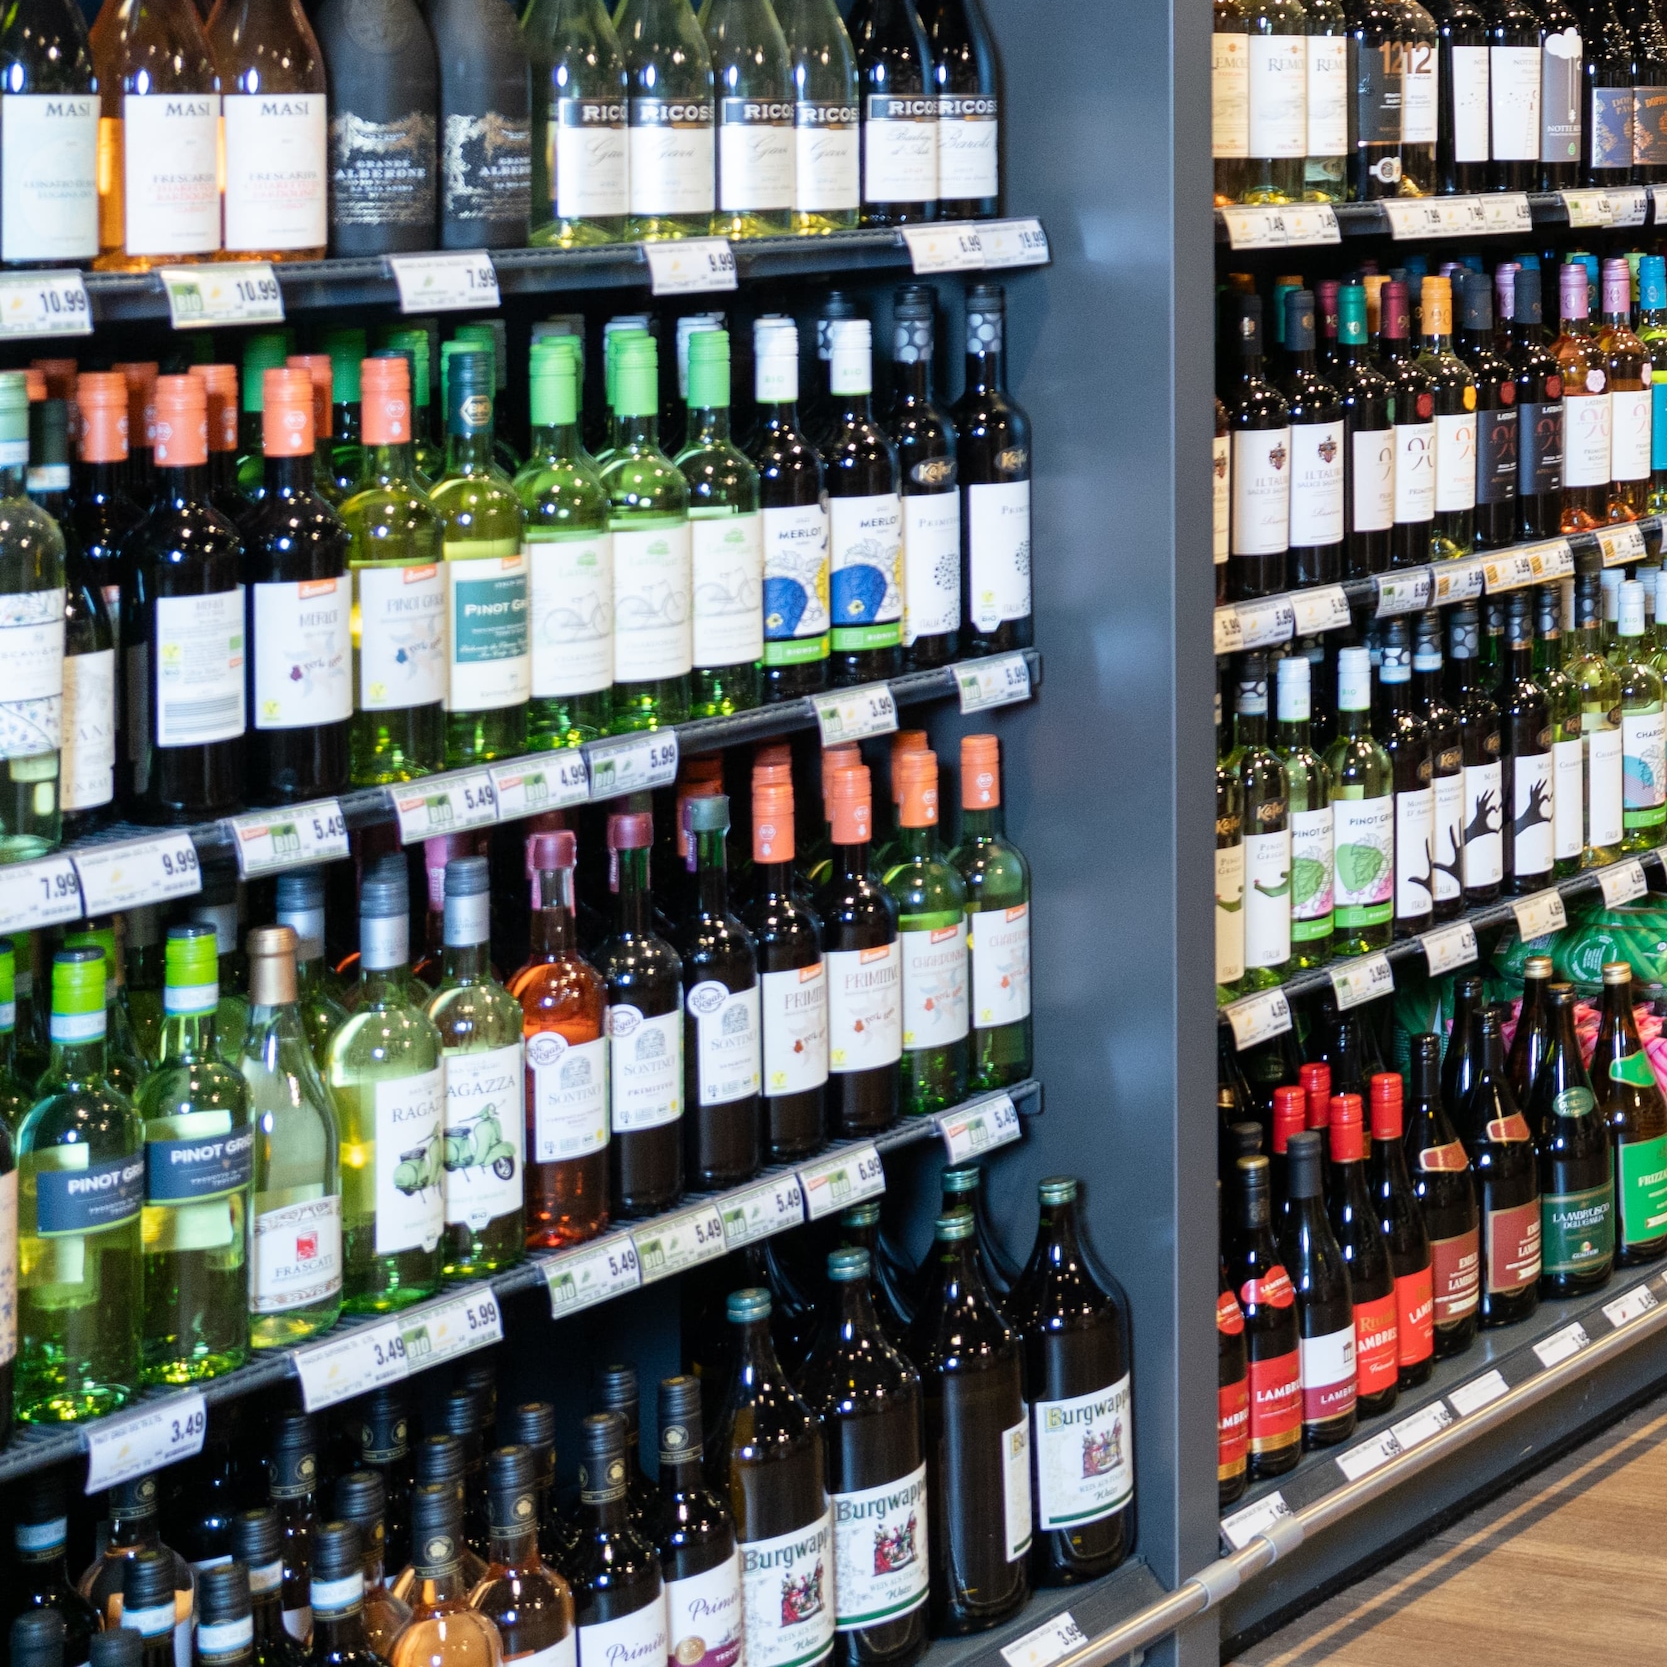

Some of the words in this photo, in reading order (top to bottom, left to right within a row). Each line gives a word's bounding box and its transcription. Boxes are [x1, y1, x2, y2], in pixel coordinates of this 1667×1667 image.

[45, 101, 90, 117] MASI
[166, 101, 211, 117] MASI
[260, 101, 310, 117] MASI
[709, 252, 734, 273] 9.99
[466, 269, 497, 289] 7.99
[39, 290, 86, 314] 10.99
[236, 280, 279, 302] 10.99
[860, 515, 899, 530] MERLOT
[465, 600, 508, 618] PINOT
[869, 698, 892, 718] 3.99
[650, 744, 675, 767] 5.99
[465, 786, 496, 809] 5.49
[314, 815, 347, 840] 5.49
[161, 850, 197, 874] 9.99
[171, 1143, 222, 1165] PINOT
[859, 1158, 884, 1182] 6.99
[68, 1172, 120, 1196] PINOT
[466, 1303, 496, 1329] 5.99
[171, 1413, 203, 1443] 3.49
